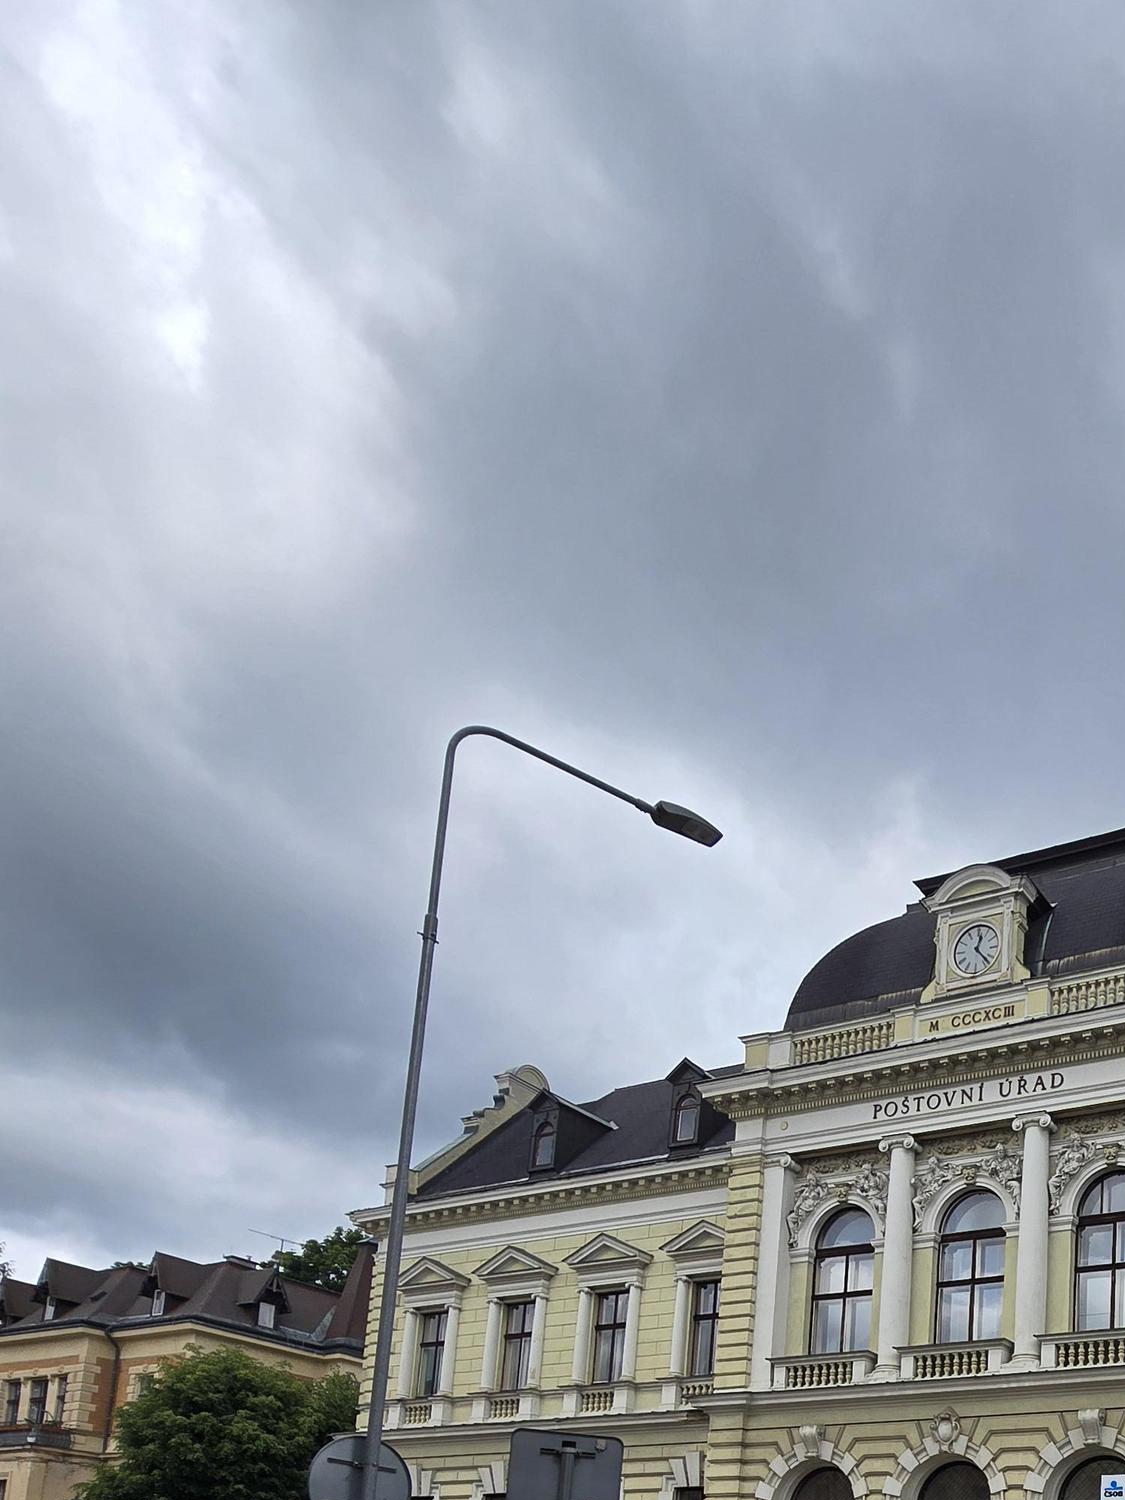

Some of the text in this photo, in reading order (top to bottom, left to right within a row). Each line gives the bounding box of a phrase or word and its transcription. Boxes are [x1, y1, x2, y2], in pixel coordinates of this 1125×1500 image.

[928, 1020, 940, 1033] M
[872, 1072, 1065, 1120] POŠTOVNÍ ÚŘAD
